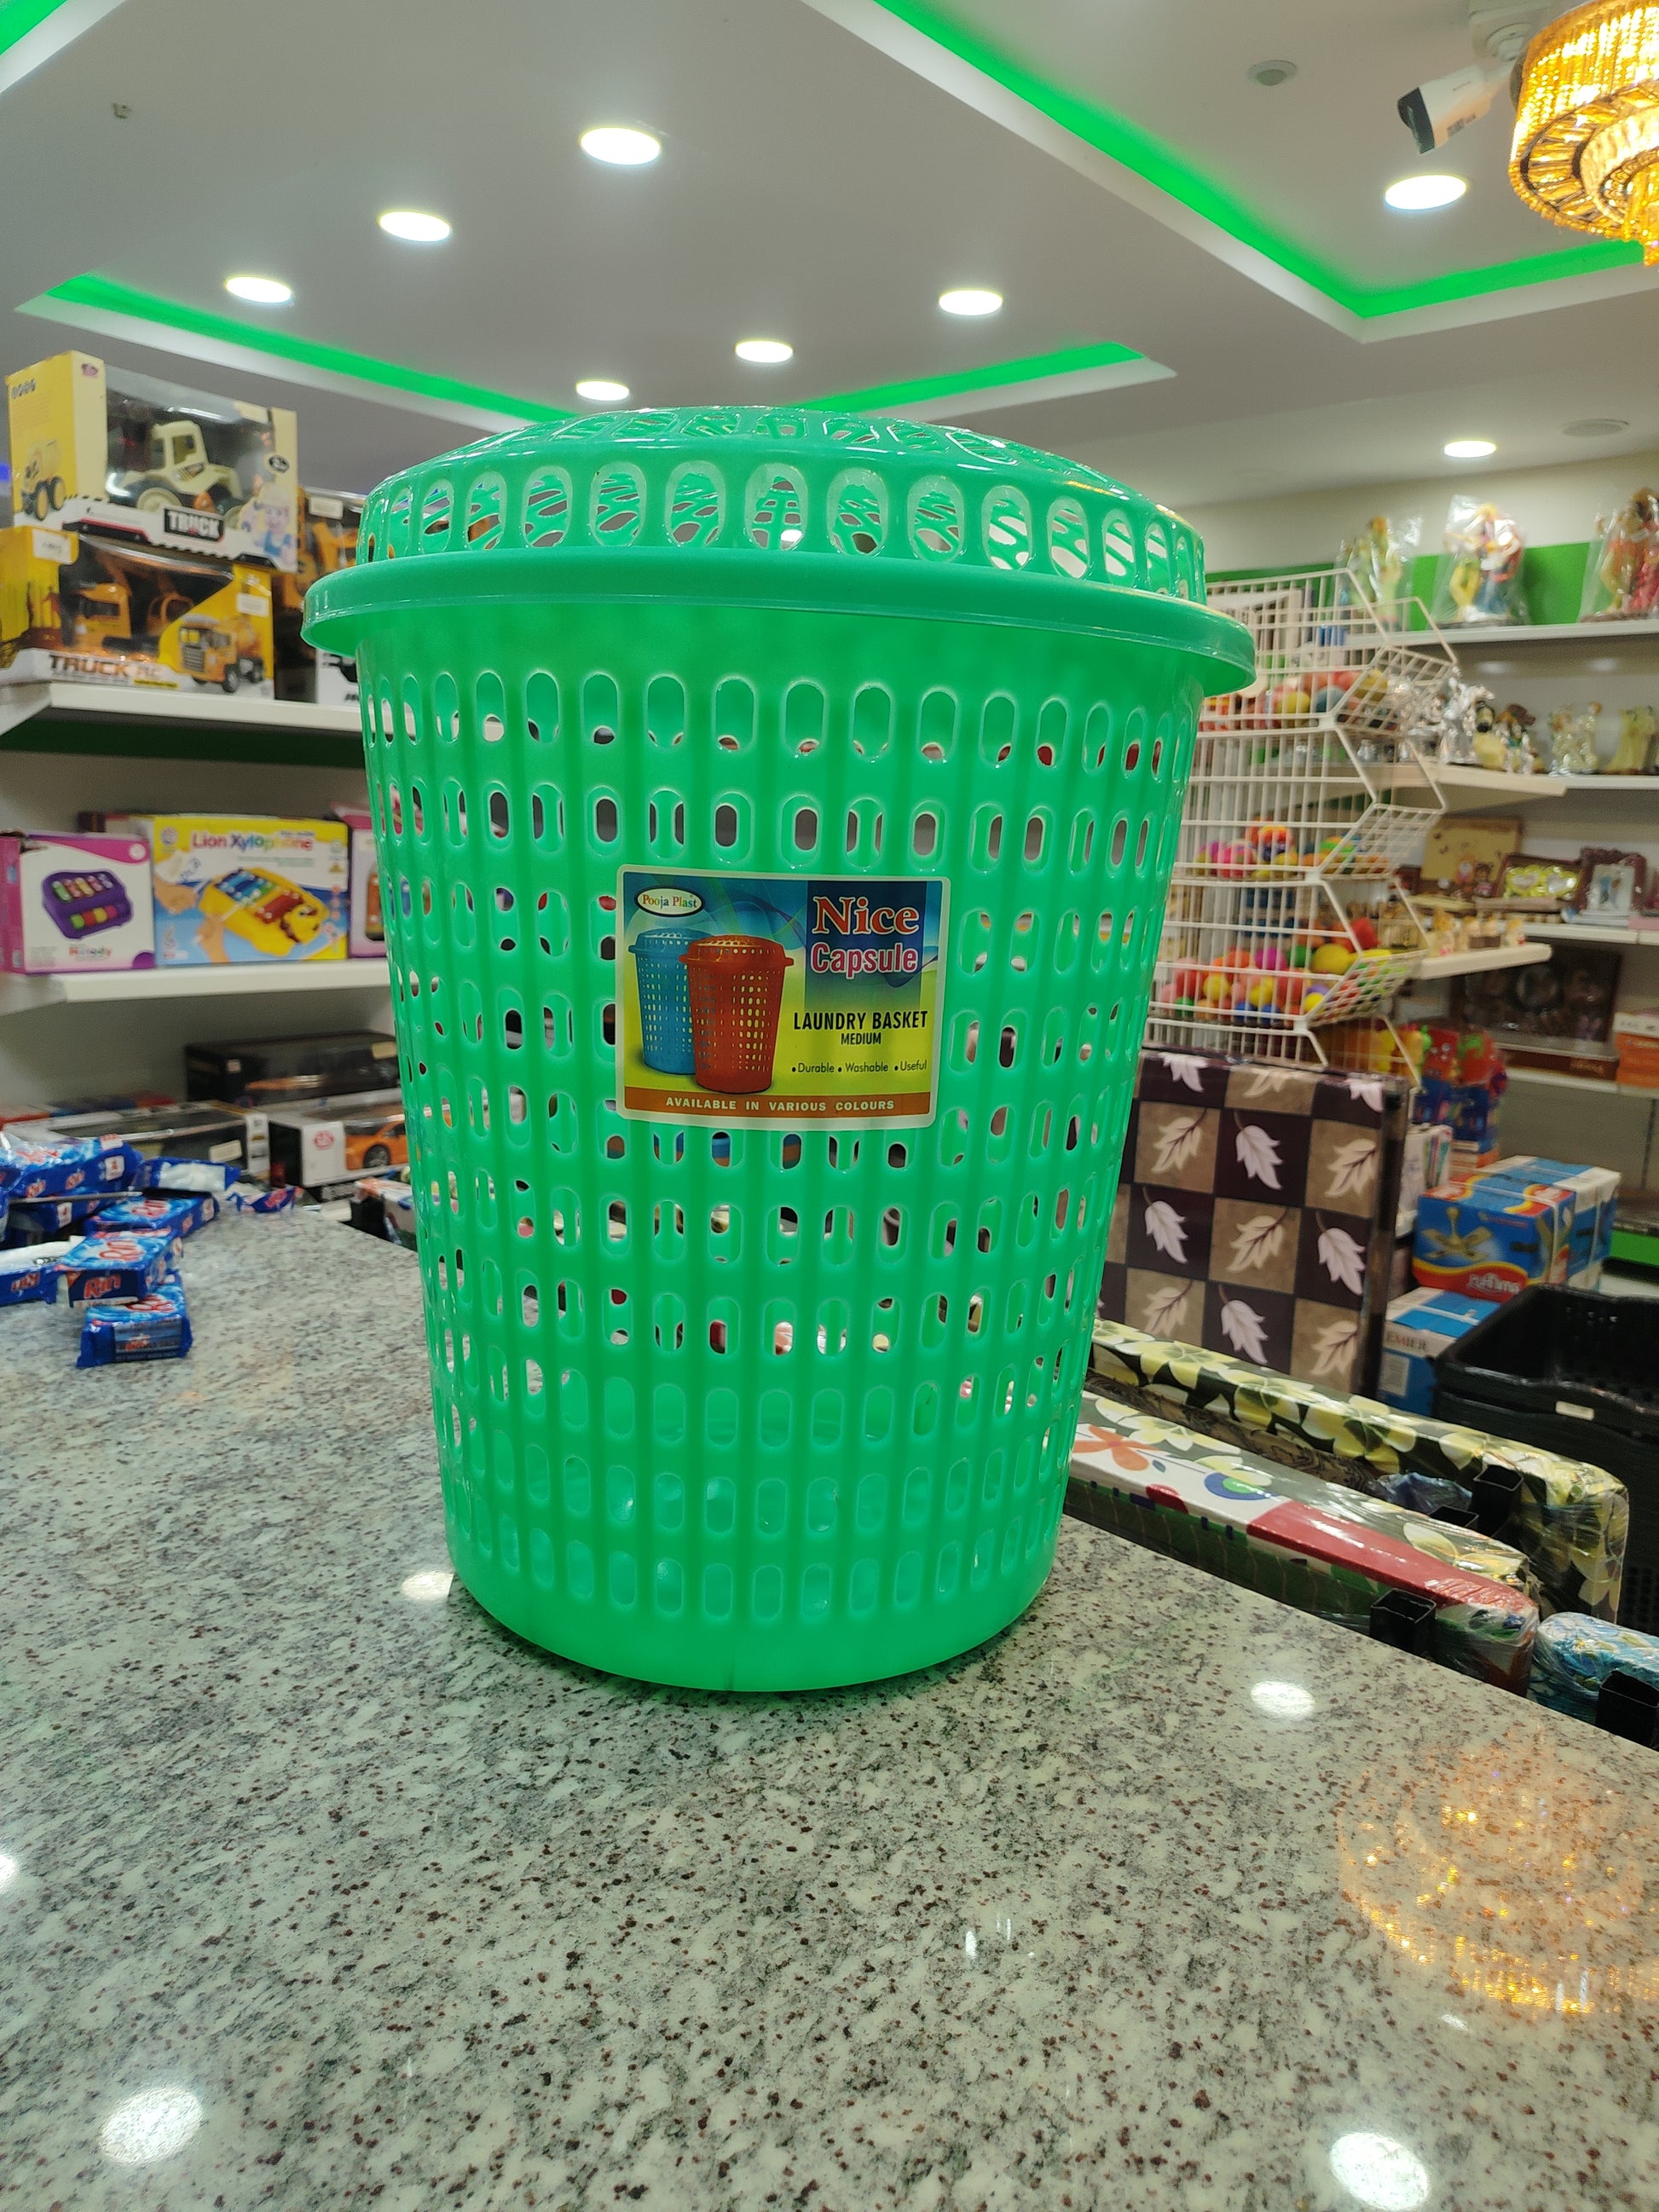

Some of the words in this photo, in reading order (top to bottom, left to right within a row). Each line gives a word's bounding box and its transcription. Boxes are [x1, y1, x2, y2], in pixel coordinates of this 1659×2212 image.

[167, 511, 220, 539] TRUCK
[49, 654, 129, 678] TRUCK
[191, 832, 228, 849] Lion
[642, 893, 669, 910] Pooja
[672, 896, 697, 908] Plast
[812, 895, 919, 935] Nice
[810, 942, 919, 979] Capsule
[794, 1012, 867, 1031] LAUNDRY
[872, 1010, 928, 1030] BASKET
[841, 1031, 882, 1045] MEDIUM
[797, 1062, 835, 1073] Durable
[845, 1060, 888, 1072] Washable
[900, 1059, 928, 1071] Useful
[666, 1096, 737, 1110] AVAILABLE
[745, 1100, 760, 1110] IN
[769, 1101, 827, 1112] VARIOUS
[835, 1100, 894, 1111] COLOURS
[83, 1273, 121, 1299] Rin
